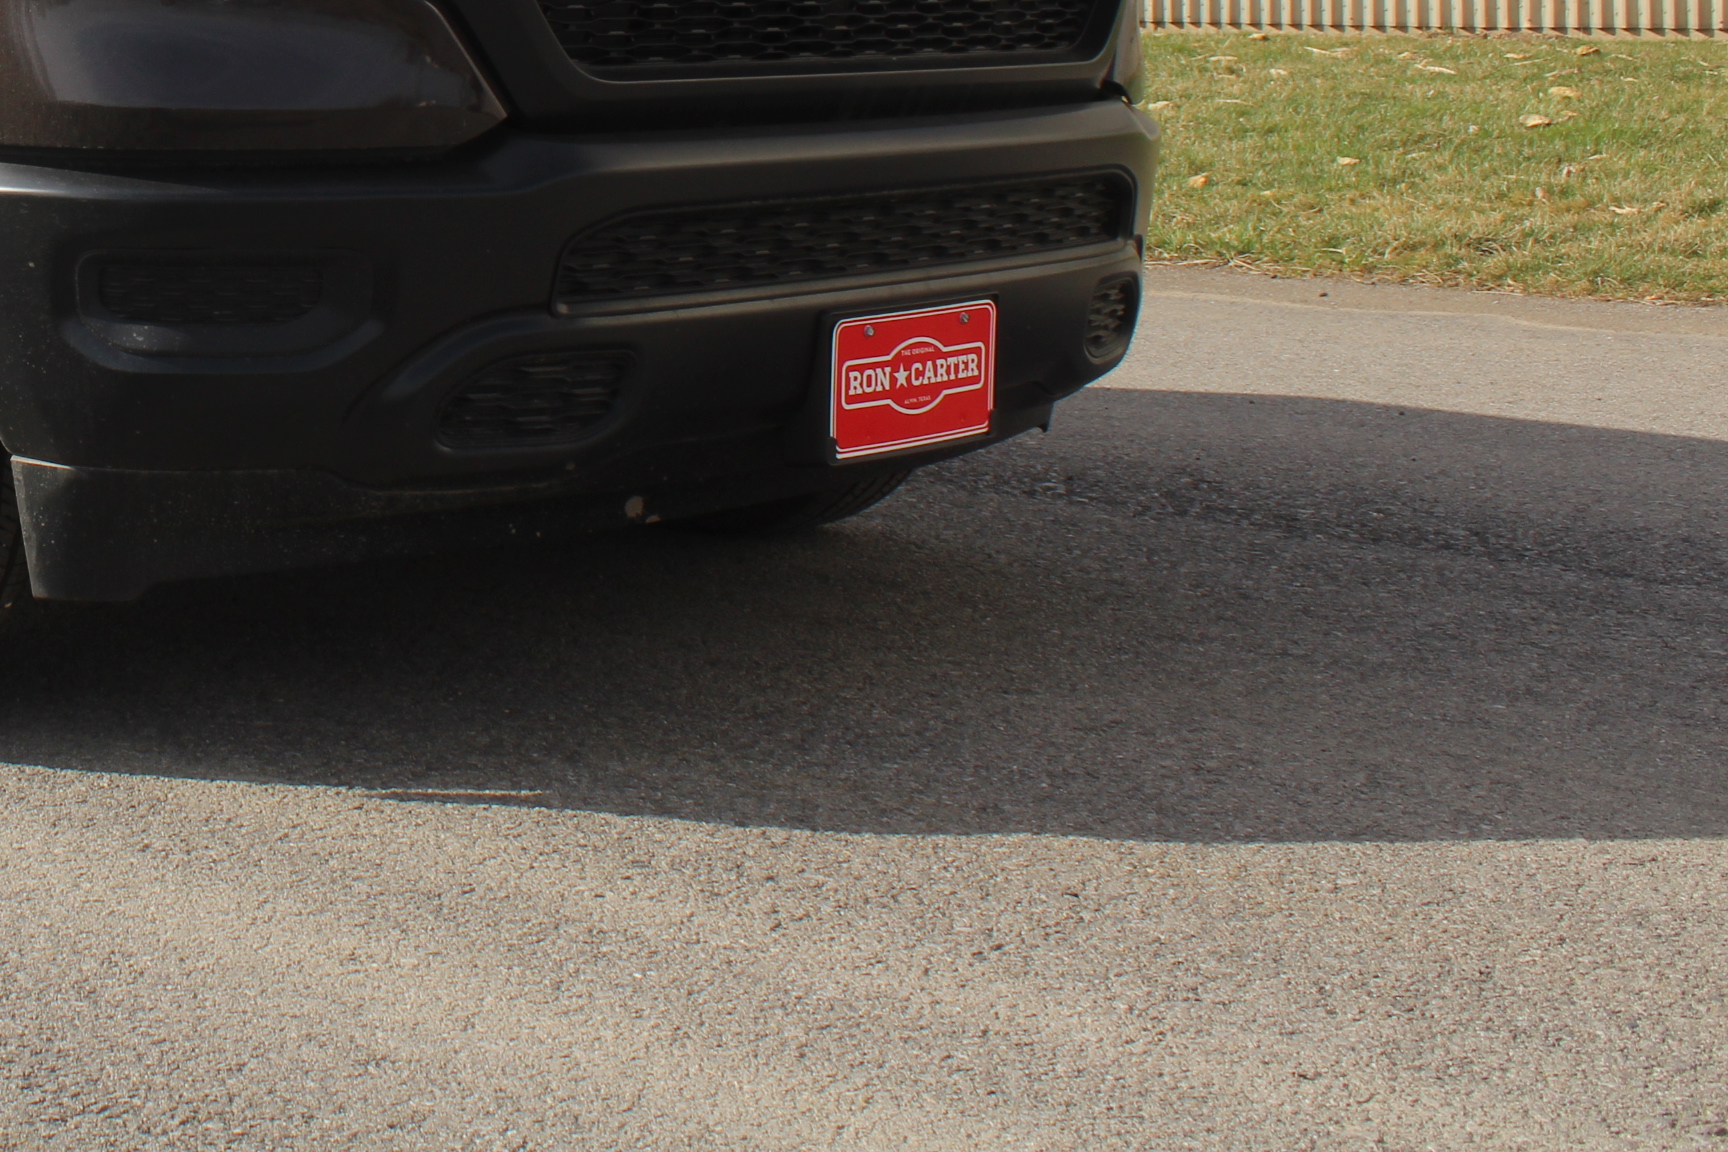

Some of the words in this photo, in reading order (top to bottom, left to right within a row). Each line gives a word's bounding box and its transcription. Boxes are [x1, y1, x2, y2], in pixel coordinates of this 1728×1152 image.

[901, 348, 911, 357] THE
[912, 346, 935, 355] ORIGINAL
[848, 366, 892, 395] RON
[911, 353, 979, 386] CARTER
[918, 395, 932, 403] TEXAS
